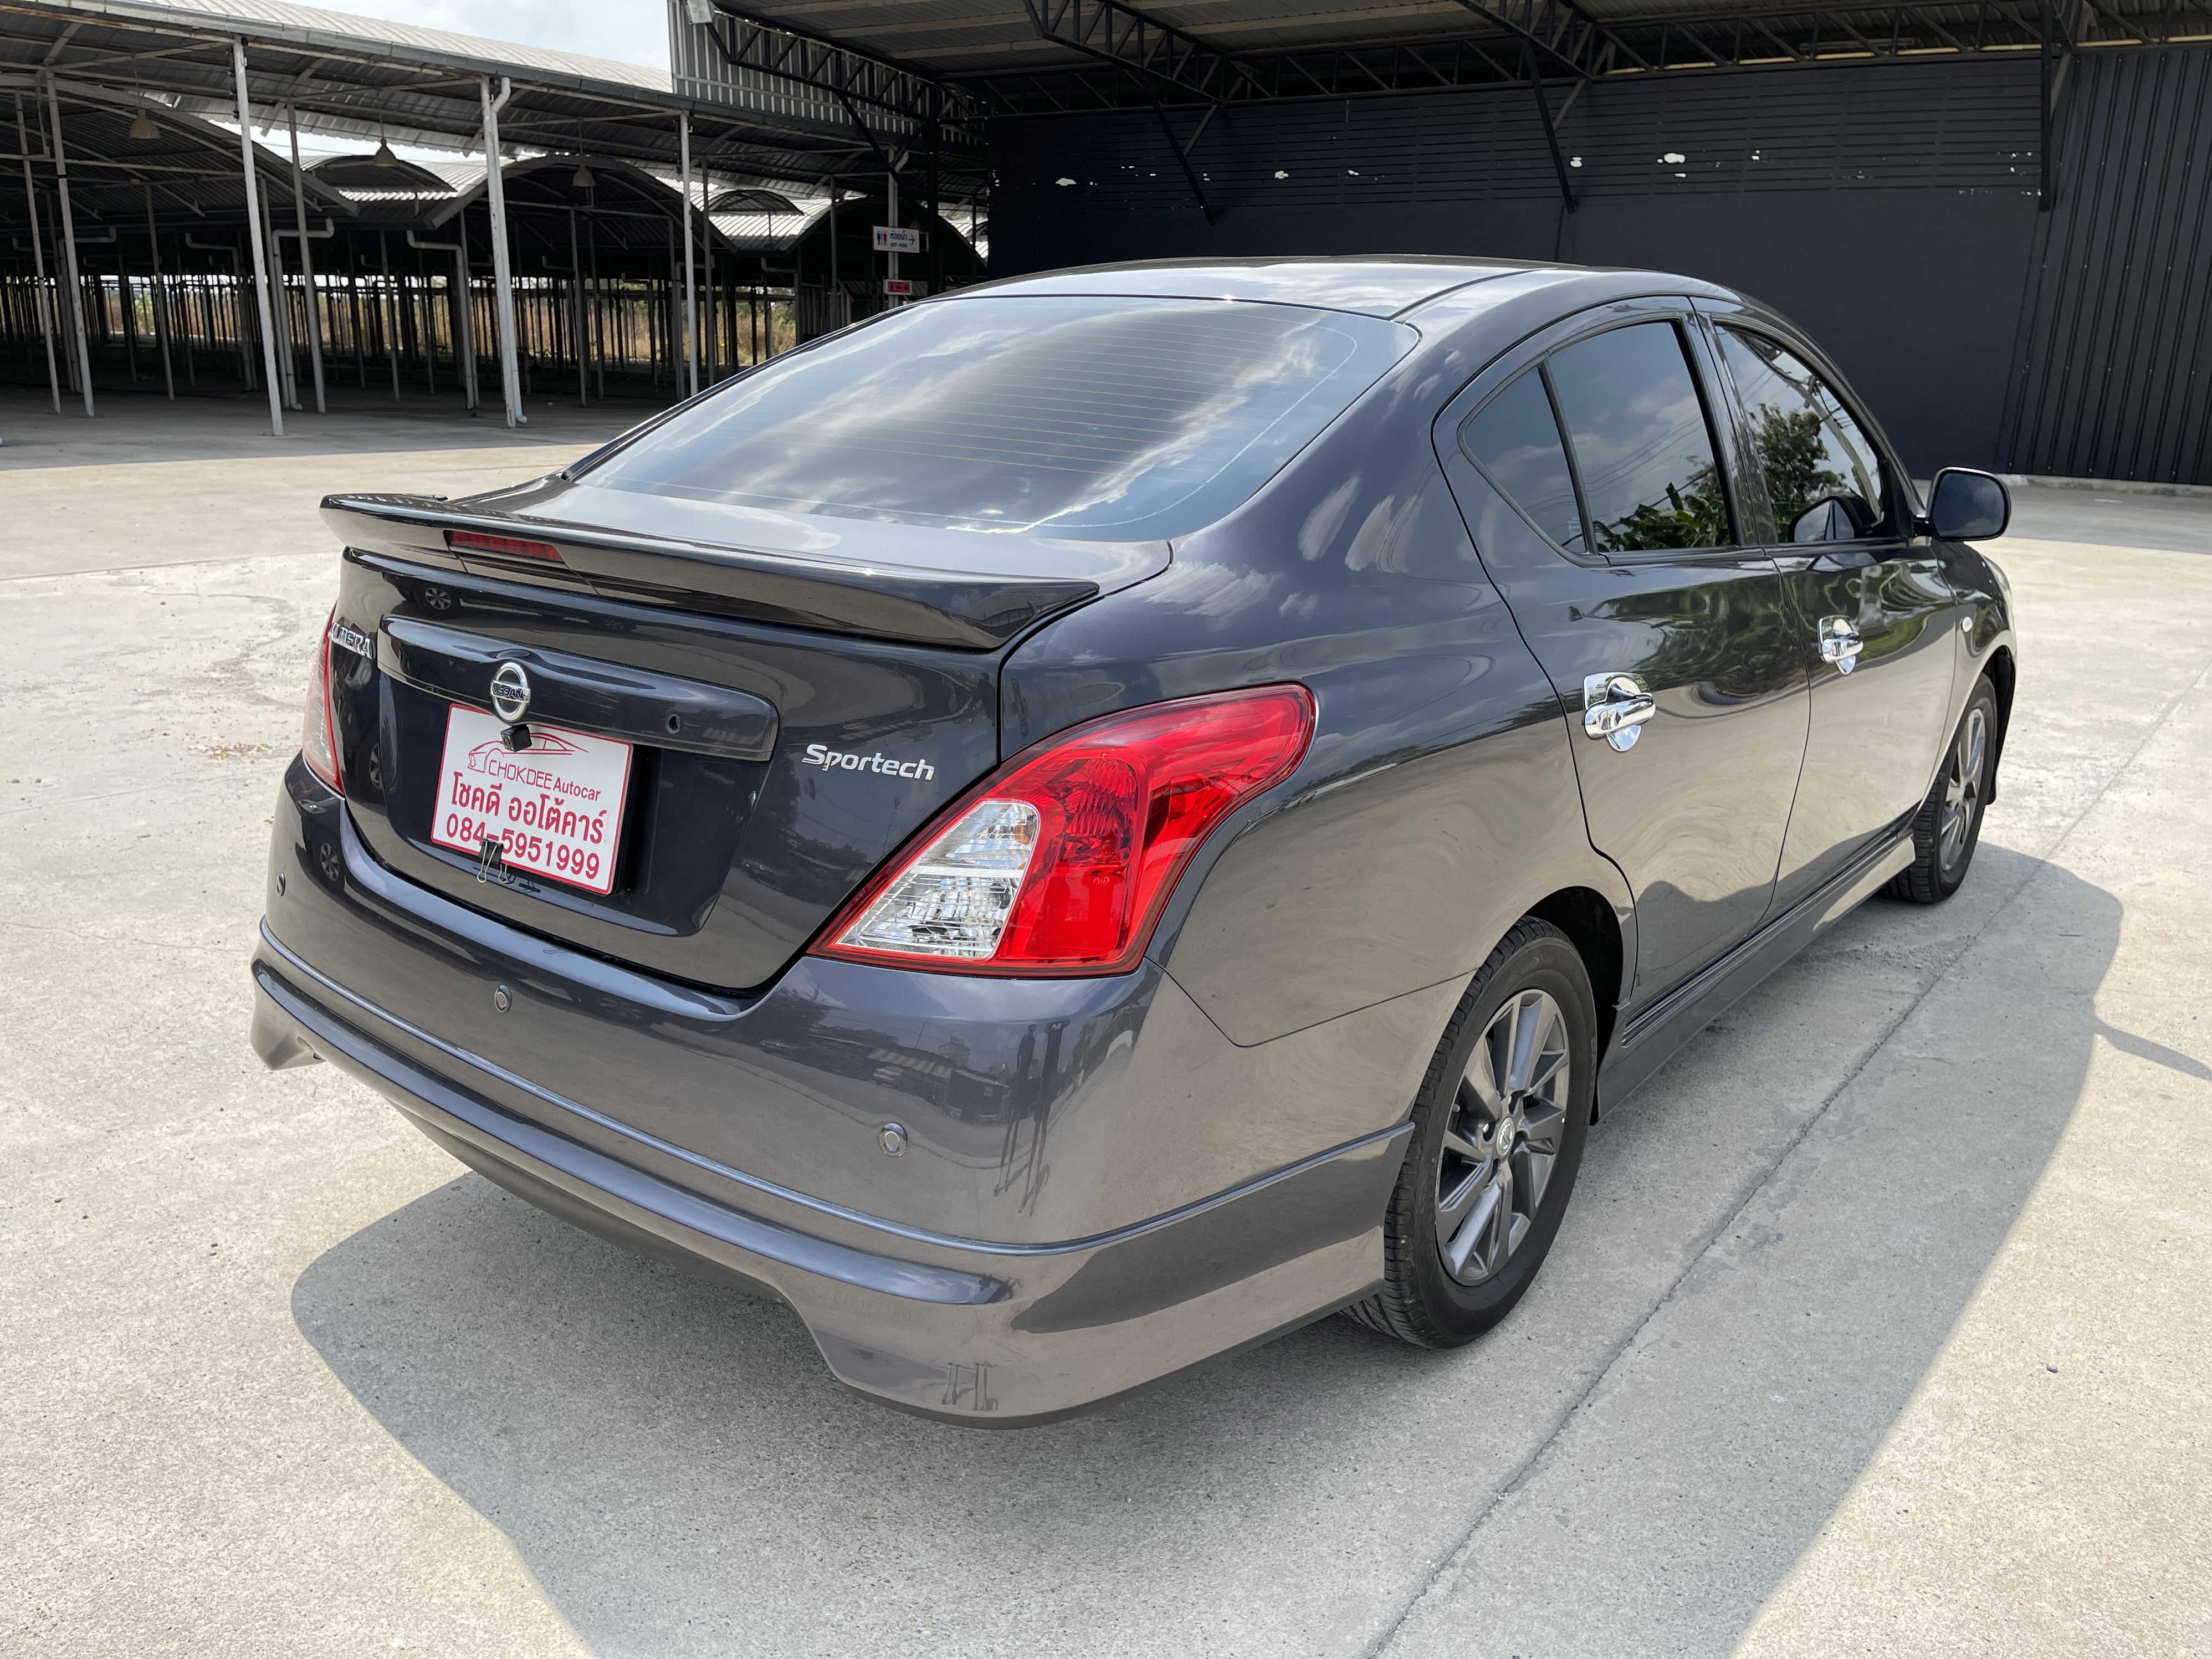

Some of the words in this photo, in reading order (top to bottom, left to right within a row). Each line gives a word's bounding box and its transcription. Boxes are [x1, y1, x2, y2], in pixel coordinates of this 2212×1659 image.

[489, 760, 553, 790] CHOKDEE
[553, 777, 601, 802] Autocar
[802, 744, 935, 780] Sportech
[451, 771, 503, 816] โชคดี
[508, 793, 607, 844] ออโต้คาร์
[447, 813, 600, 880] 084-5951999
